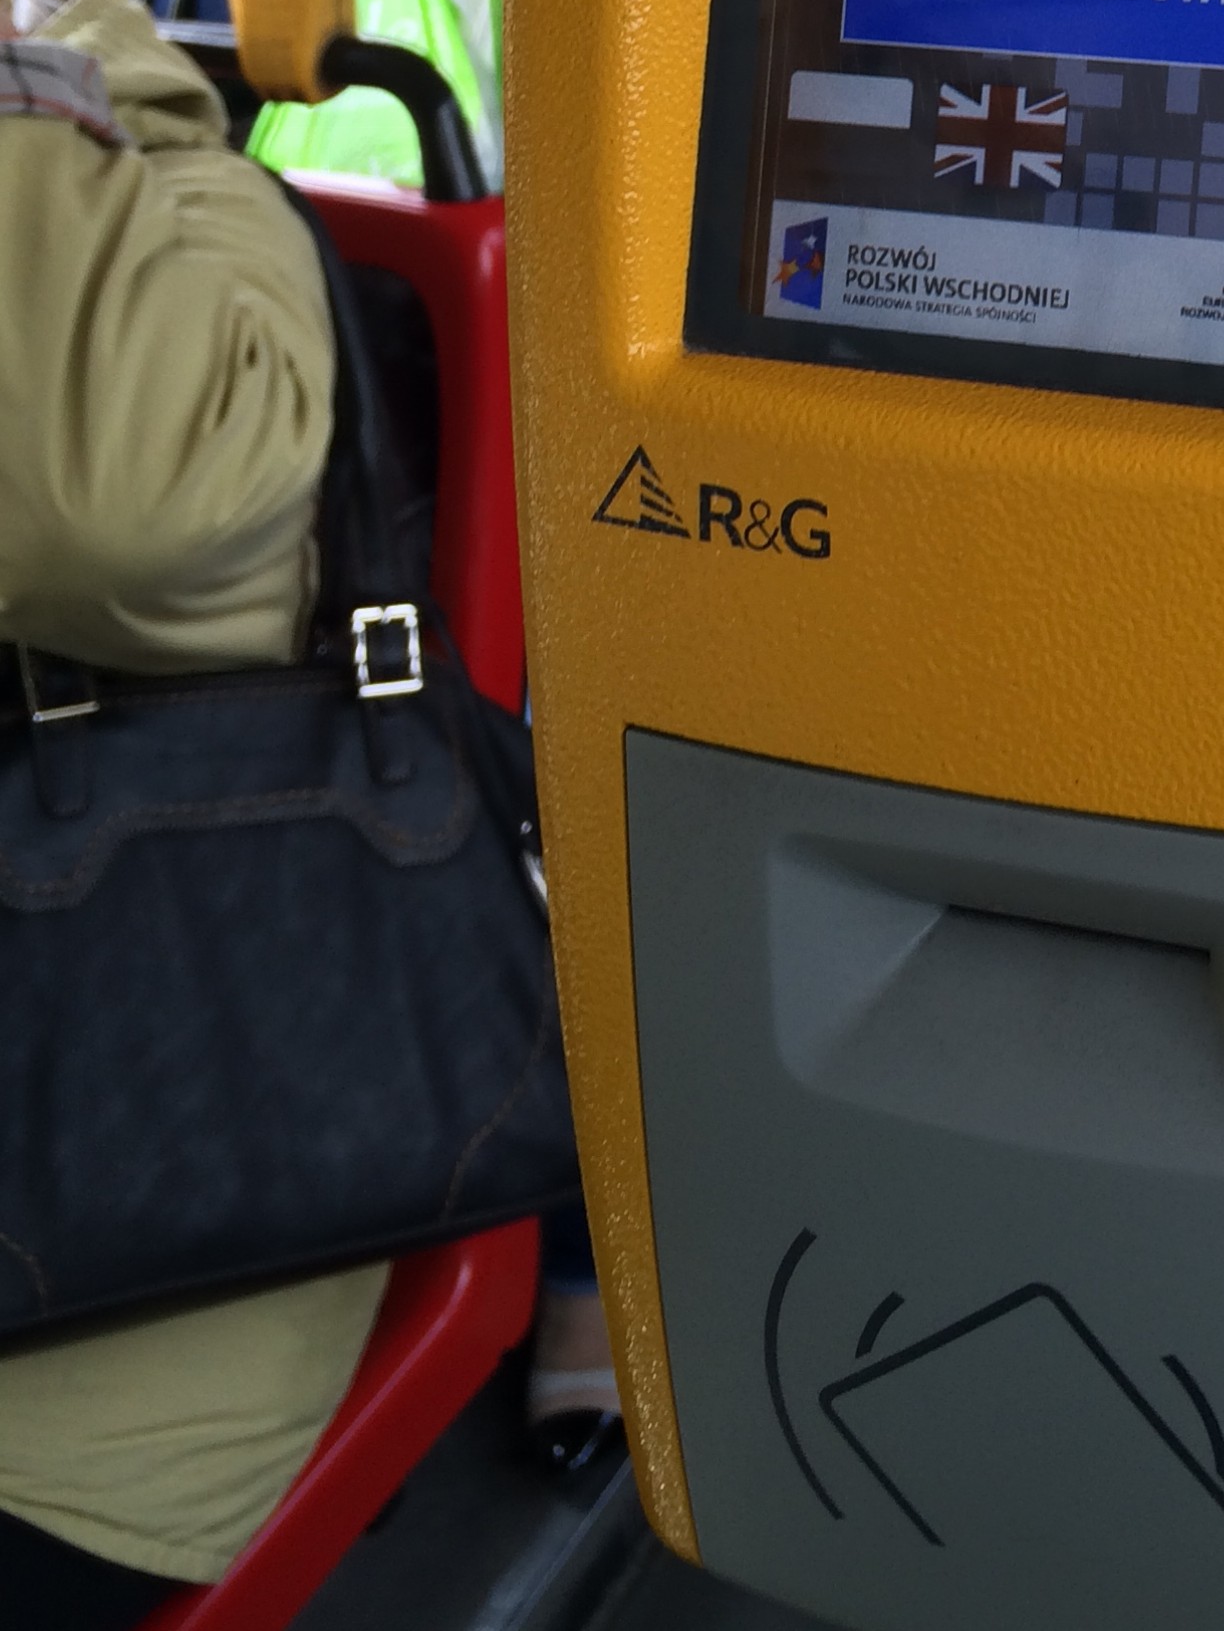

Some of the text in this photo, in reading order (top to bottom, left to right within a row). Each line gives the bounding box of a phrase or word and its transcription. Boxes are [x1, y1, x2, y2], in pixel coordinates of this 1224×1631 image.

[847, 244, 937, 271] ROZWÓJ
[843, 293, 912, 311] NARODOWA
[915, 300, 972, 317] STRATEGIA
[845, 268, 1070, 309] POLSKI WSCHODNIEJ
[699, 482, 831, 559] R&G
